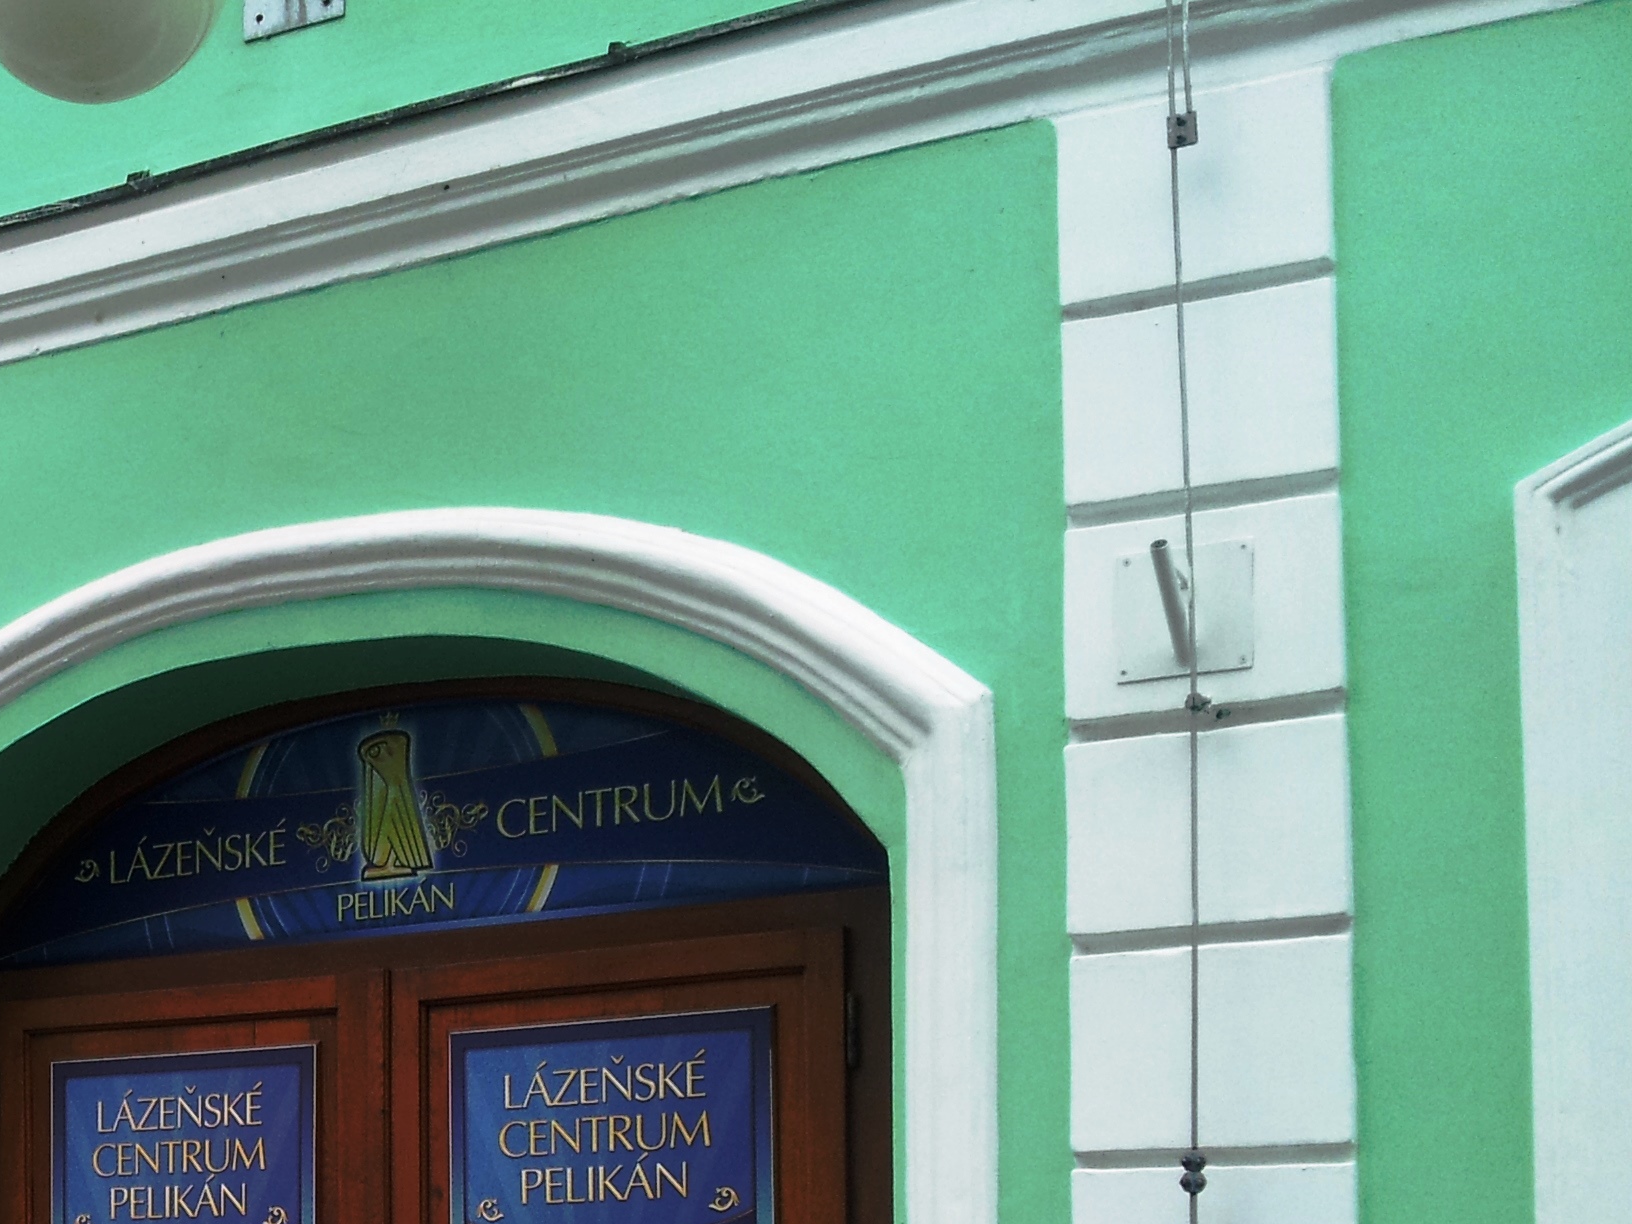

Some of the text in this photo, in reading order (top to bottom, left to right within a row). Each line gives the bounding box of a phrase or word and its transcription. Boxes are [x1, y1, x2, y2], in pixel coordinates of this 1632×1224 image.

[109, 774, 724, 885] LÁZEŇSKÉ CENTRUM
[337, 877, 456, 922] PELIKÁN
[504, 1048, 707, 1110] LÁZEŇSKÉ
[96, 1081, 263, 1133] LÁZEŇSKÉ
[92, 1137, 266, 1177] CENTRUM
[498, 1110, 711, 1158] CENTRUM
[110, 1174, 247, 1220] PELIKÁN
[521, 1152, 688, 1204] PELIKÁN
